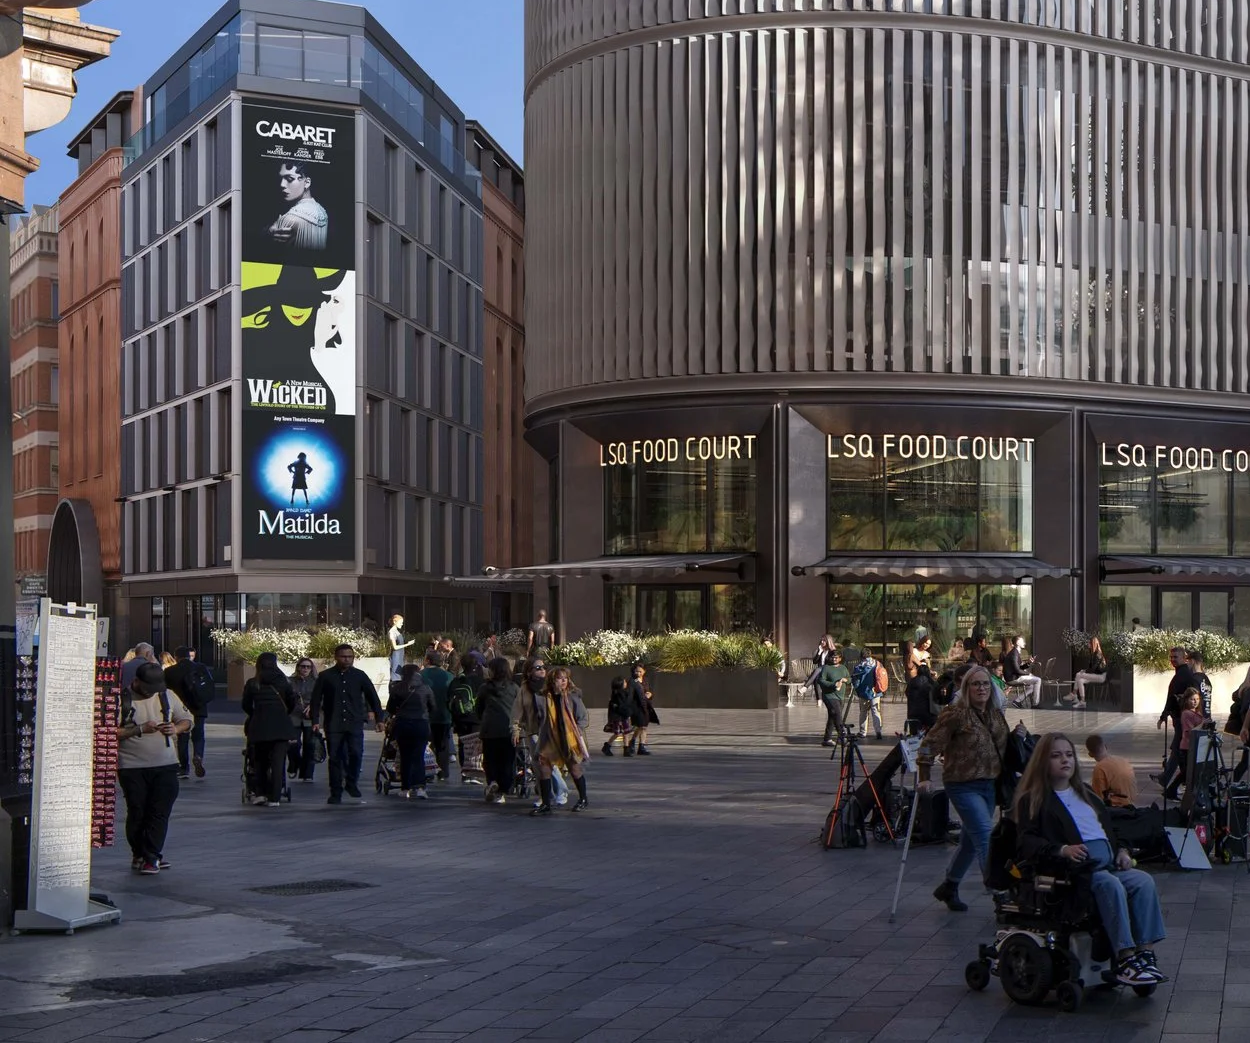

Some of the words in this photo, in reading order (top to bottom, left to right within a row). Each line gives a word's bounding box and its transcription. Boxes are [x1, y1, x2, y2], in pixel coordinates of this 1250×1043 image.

[256, 120, 336, 144] CABARET
[600, 441, 628, 467] LSQ
[632, 438, 678, 464] FOOD
[686, 435, 757, 461] COURT
[827, 434, 875, 459] LSQ
[883, 434, 947, 459] FOOD
[956, 435, 1035, 461] COURT
[1102, 442, 1147, 467] LSQ
[1155, 445, 1214, 471] FOOD
[258, 509, 341, 535] Matilda
